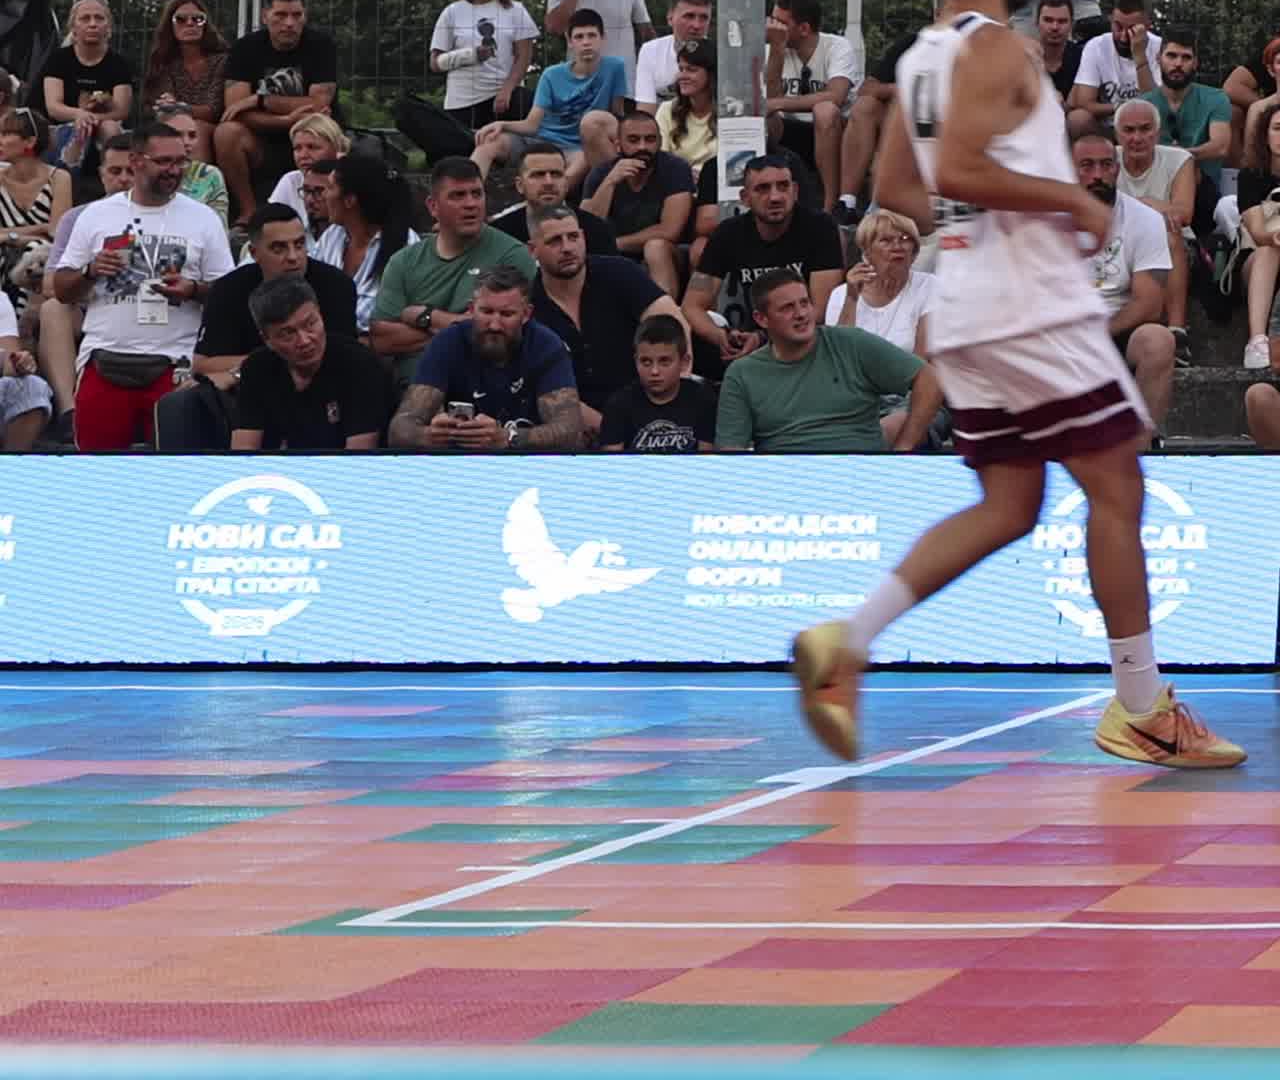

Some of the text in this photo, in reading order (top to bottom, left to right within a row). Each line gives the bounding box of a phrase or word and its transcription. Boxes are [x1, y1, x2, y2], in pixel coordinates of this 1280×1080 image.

[168, 523, 343, 549] НОВИ САД
[692, 515, 878, 536] НОВОСАДСКИ
[1140, 524, 1208, 550] САД
[687, 540, 881, 563] ОМЛАДИНСКИ
[176, 576, 321, 595] ГРАД СПОРТА
[686, 567, 783, 586] ФОРУМ
